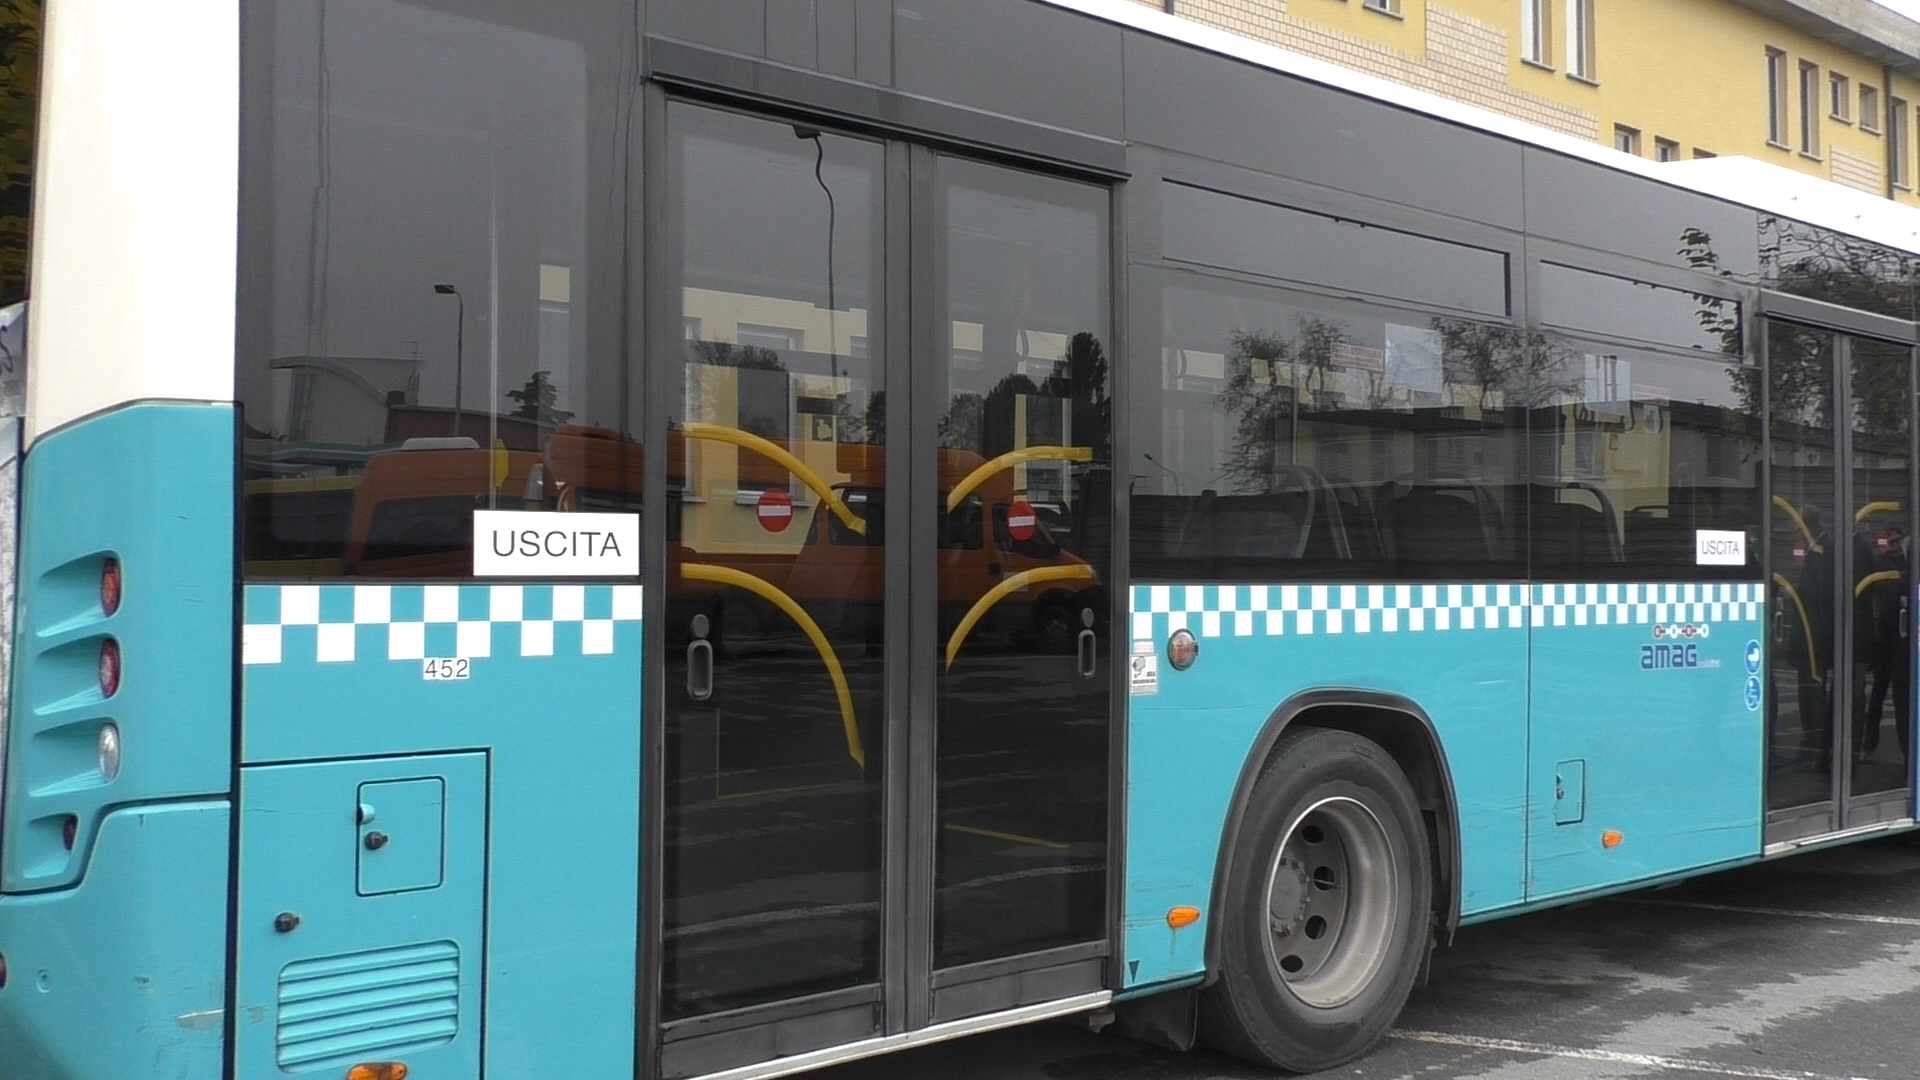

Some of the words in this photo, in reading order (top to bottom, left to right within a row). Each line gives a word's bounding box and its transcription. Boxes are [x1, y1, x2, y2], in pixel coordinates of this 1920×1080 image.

[492, 530, 622, 557] USCITA
[1701, 540, 1740, 555] USCITA
[425, 659, 468, 678] 452
